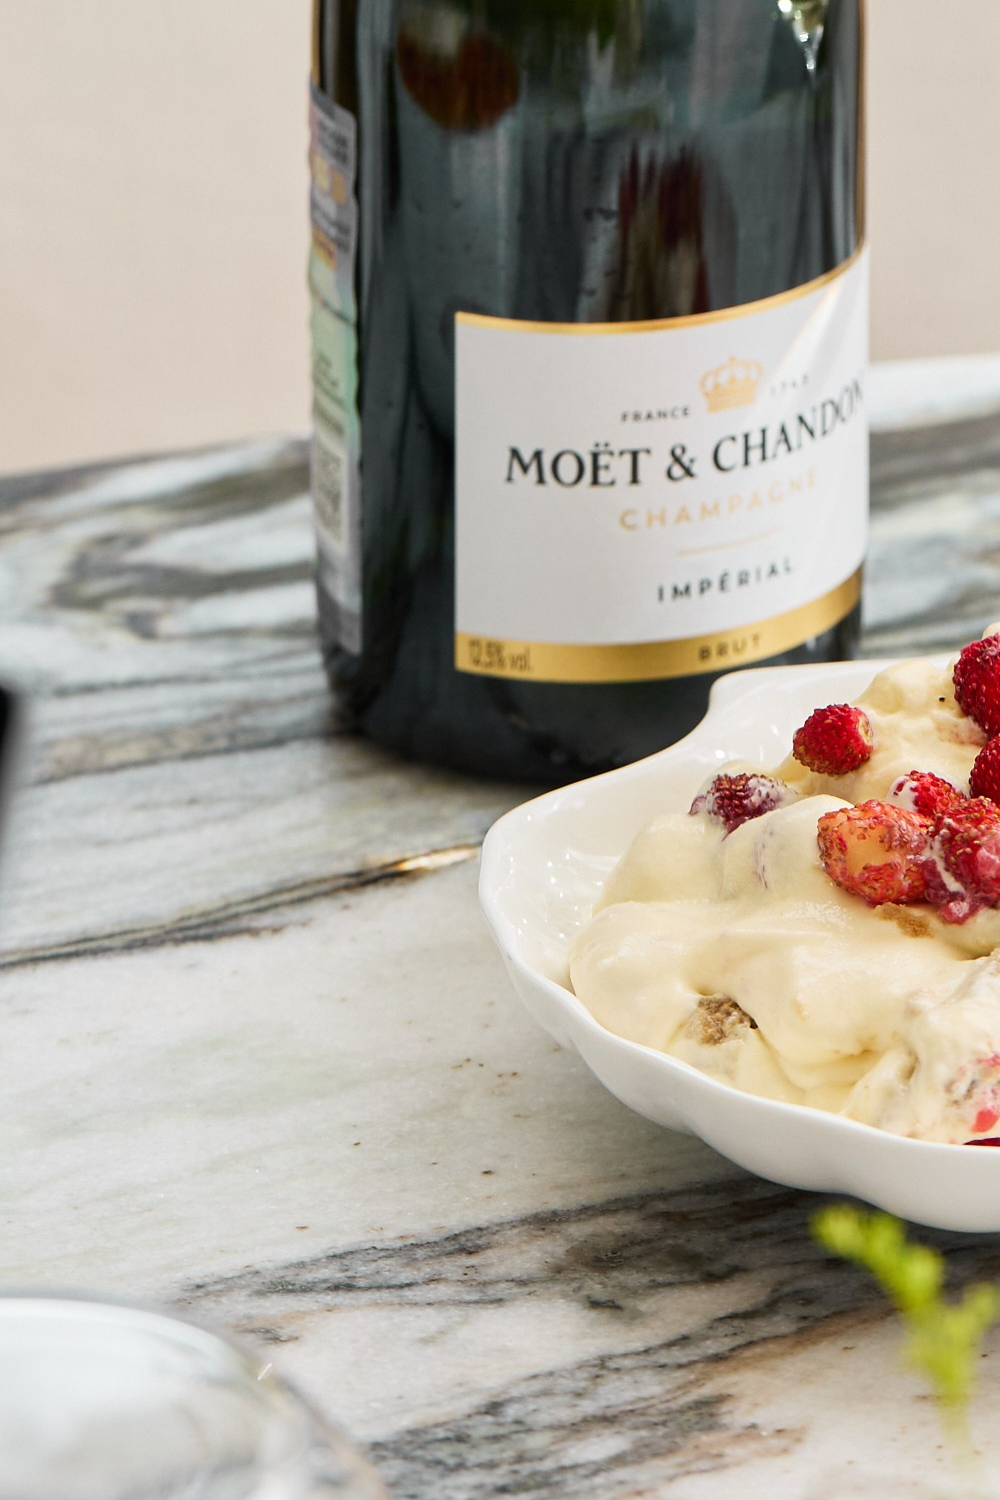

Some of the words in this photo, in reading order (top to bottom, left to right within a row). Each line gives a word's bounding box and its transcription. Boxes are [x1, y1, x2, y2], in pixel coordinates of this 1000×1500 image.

[621, 405, 691, 423] FRANCE
[505, 441, 652, 487] MOËT
[666, 443, 697, 482] &
[619, 467, 817, 531] CHAMPAGNE
[657, 556, 794, 602] IMPÉRIAL
[698, 634, 761, 660] BRUT
